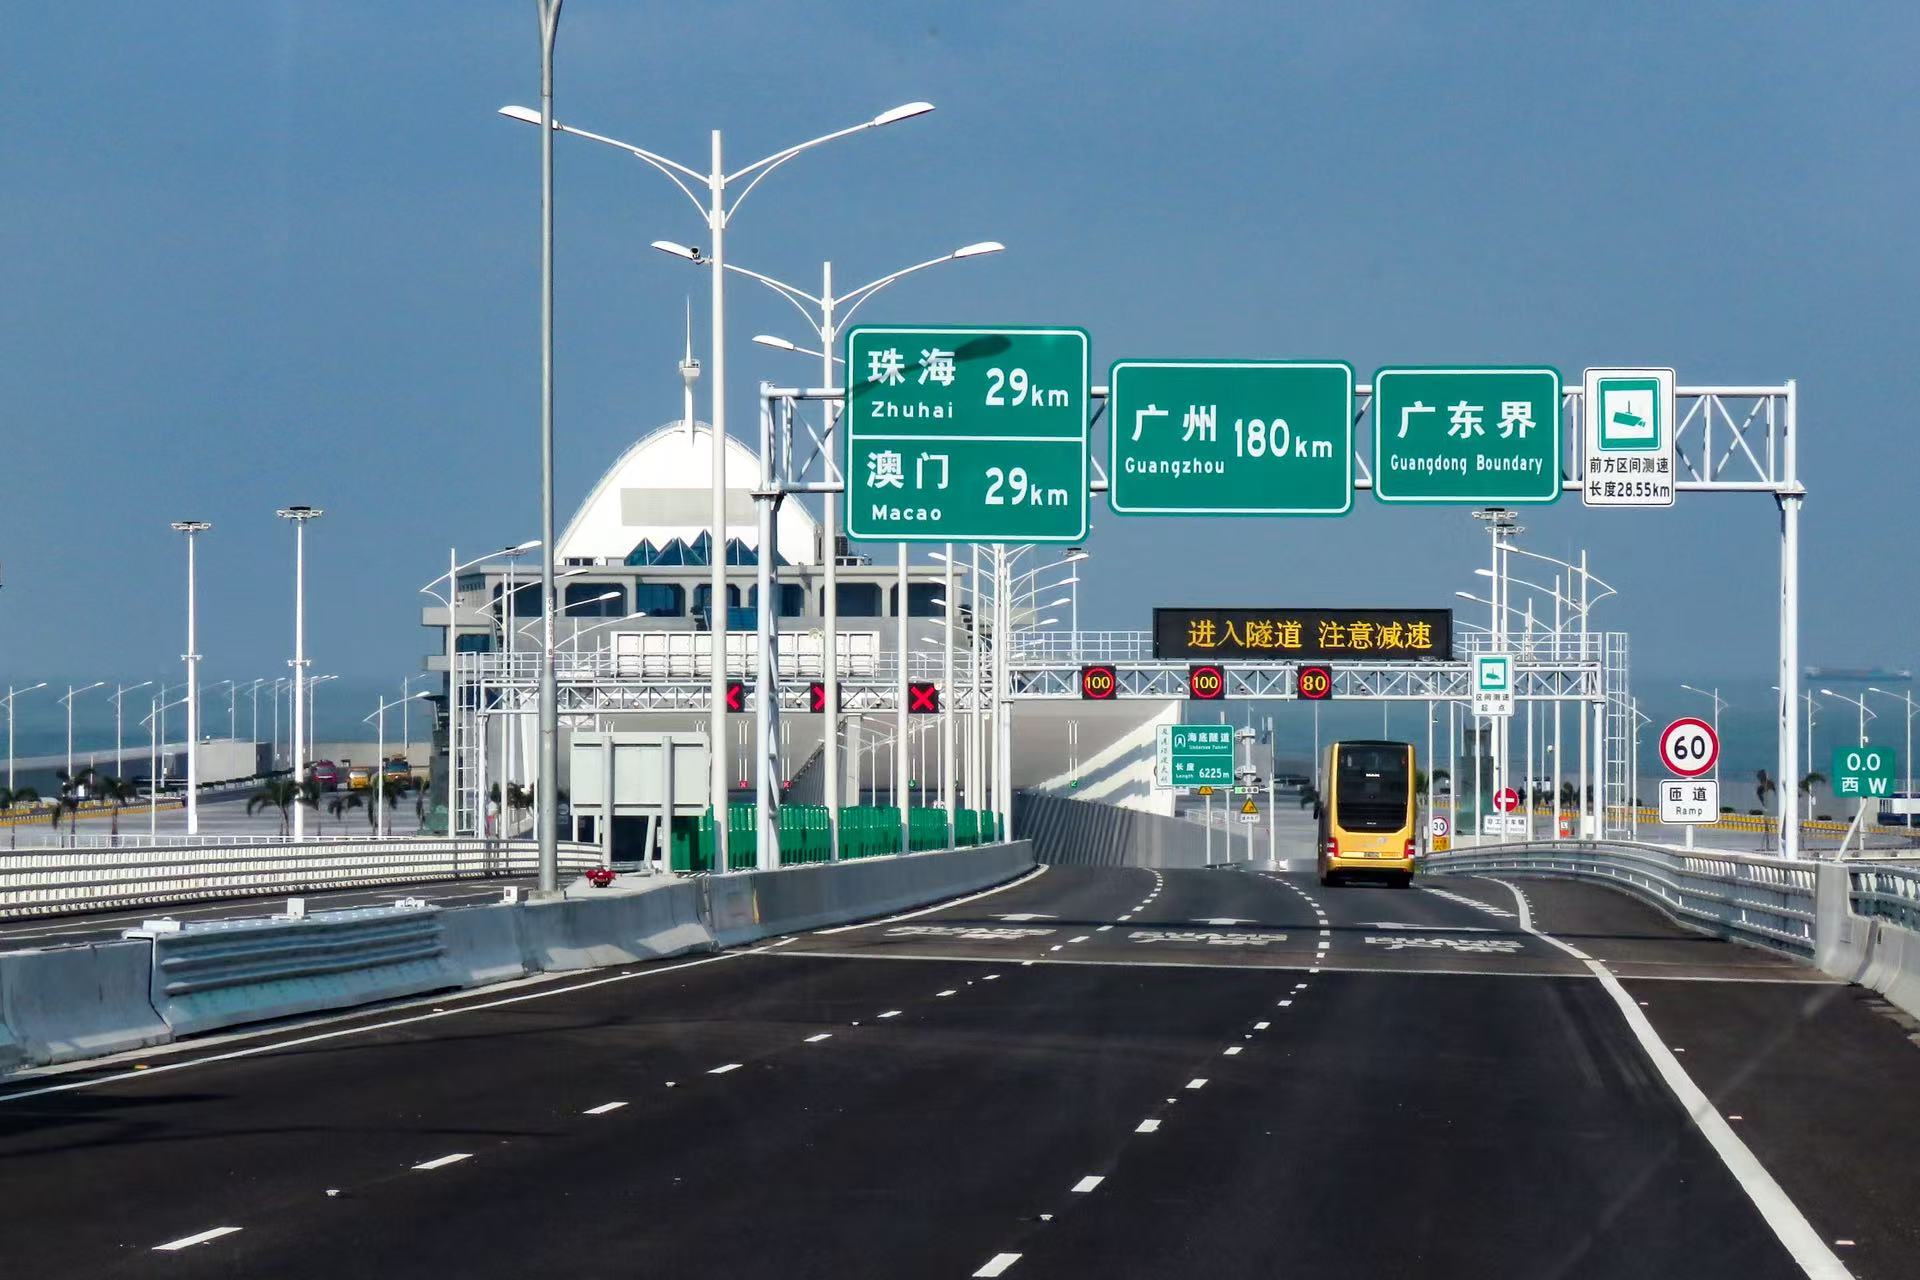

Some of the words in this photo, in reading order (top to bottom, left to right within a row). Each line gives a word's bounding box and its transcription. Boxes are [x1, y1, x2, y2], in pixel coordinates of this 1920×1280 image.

[867, 347, 956, 387] 珠海
[985, 367, 1069, 407] 29km
[871, 401, 953, 418] Zhuhai
[1131, 403, 1217, 442] 广州
[1397, 400, 1537, 439] 广东界
[1234, 418, 1333, 458] 180km
[866, 450, 950, 490] 澳门
[1125, 457, 1225, 479] Guangzhou
[1390, 453, 1467, 475] Guangdong
[1476, 454, 1543, 475] Boundary
[1589, 456, 1669, 473] 前方区间测速
[985, 467, 1068, 506] 29km
[871, 504, 942, 521] Macao
[1187, 620, 1302, 650] 进入隧道
[1318, 621, 1433, 649] 注意减速
[1085, 675, 1110, 690] 100
[1193, 675, 1218, 690] 100
[1303, 676, 1326, 691] 80
[1188, 732, 1230, 743] 海底隧道
[1674, 736, 1705, 760] 60
[1175, 763, 1195, 771] 长度
[1847, 753, 1881, 772] 0.0
[1669, 787, 1707, 802] 匝道
[1841, 777, 1859, 793] 西
[1868, 778, 1887, 794] W
[1675, 806, 1703, 816] Ramp
[1434, 822, 1445, 831] 30
